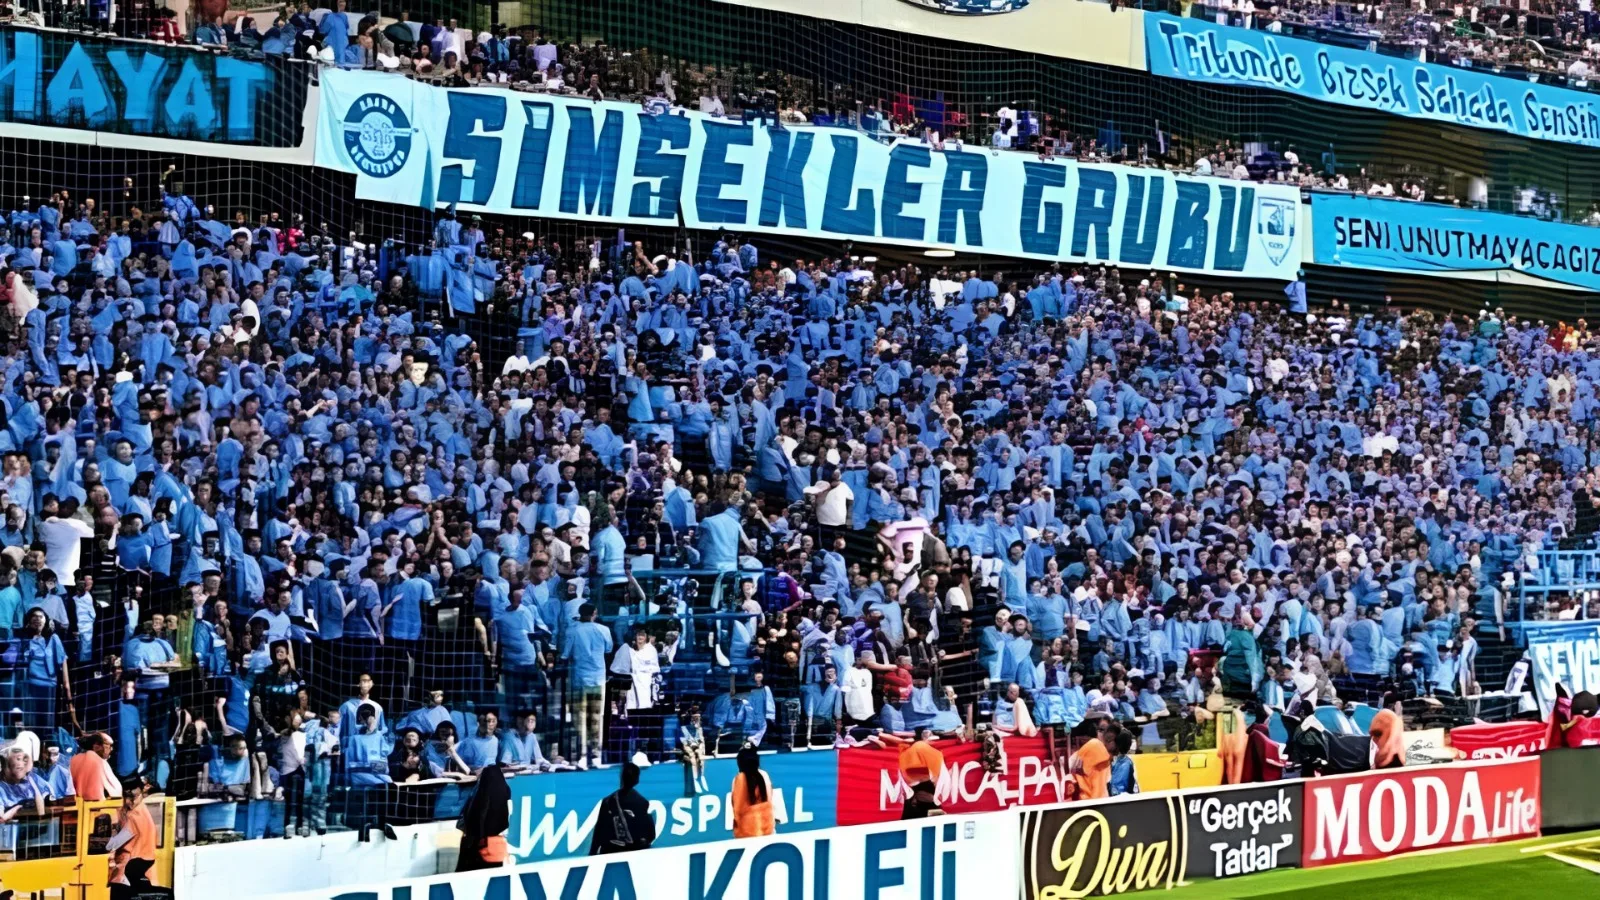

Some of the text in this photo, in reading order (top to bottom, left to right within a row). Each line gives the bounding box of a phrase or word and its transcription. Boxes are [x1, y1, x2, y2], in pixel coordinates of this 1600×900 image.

[1020, 161, 1255, 271] GRUBU
[1039, 809, 1168, 899] Diva
[1310, 771, 1489, 860] MODA
